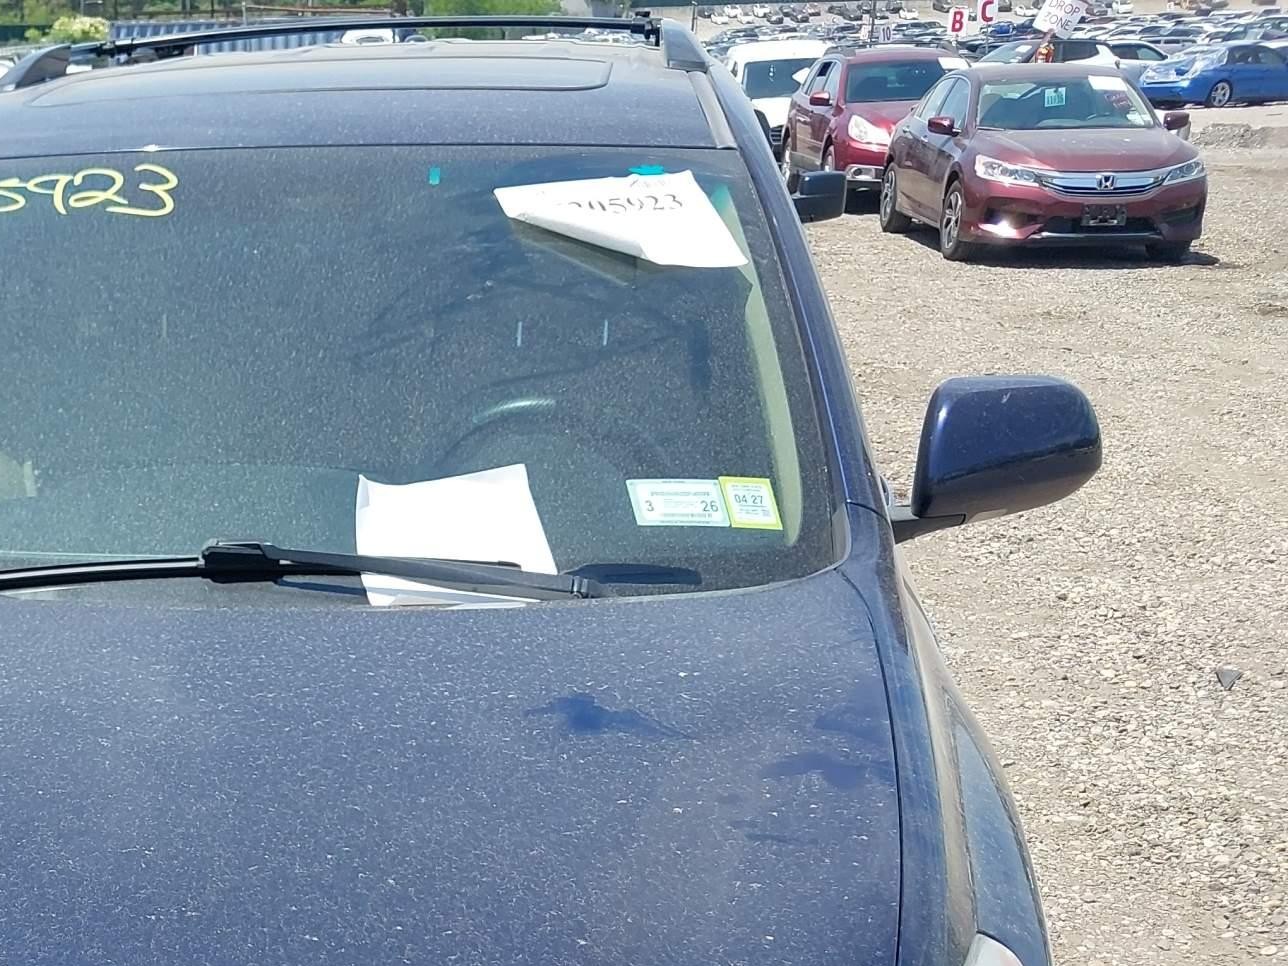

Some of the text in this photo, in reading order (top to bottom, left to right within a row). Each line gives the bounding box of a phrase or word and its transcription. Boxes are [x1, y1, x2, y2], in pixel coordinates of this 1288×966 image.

[981, 0, 994, 22] C
[1049, 0, 1080, 16] DROP
[951, 11, 963, 32] B
[881, 26, 891, 41] 10
[644, 500, 654, 512] 3
[700, 500, 719, 512] 26
[751, 494, 763, 505] 27
